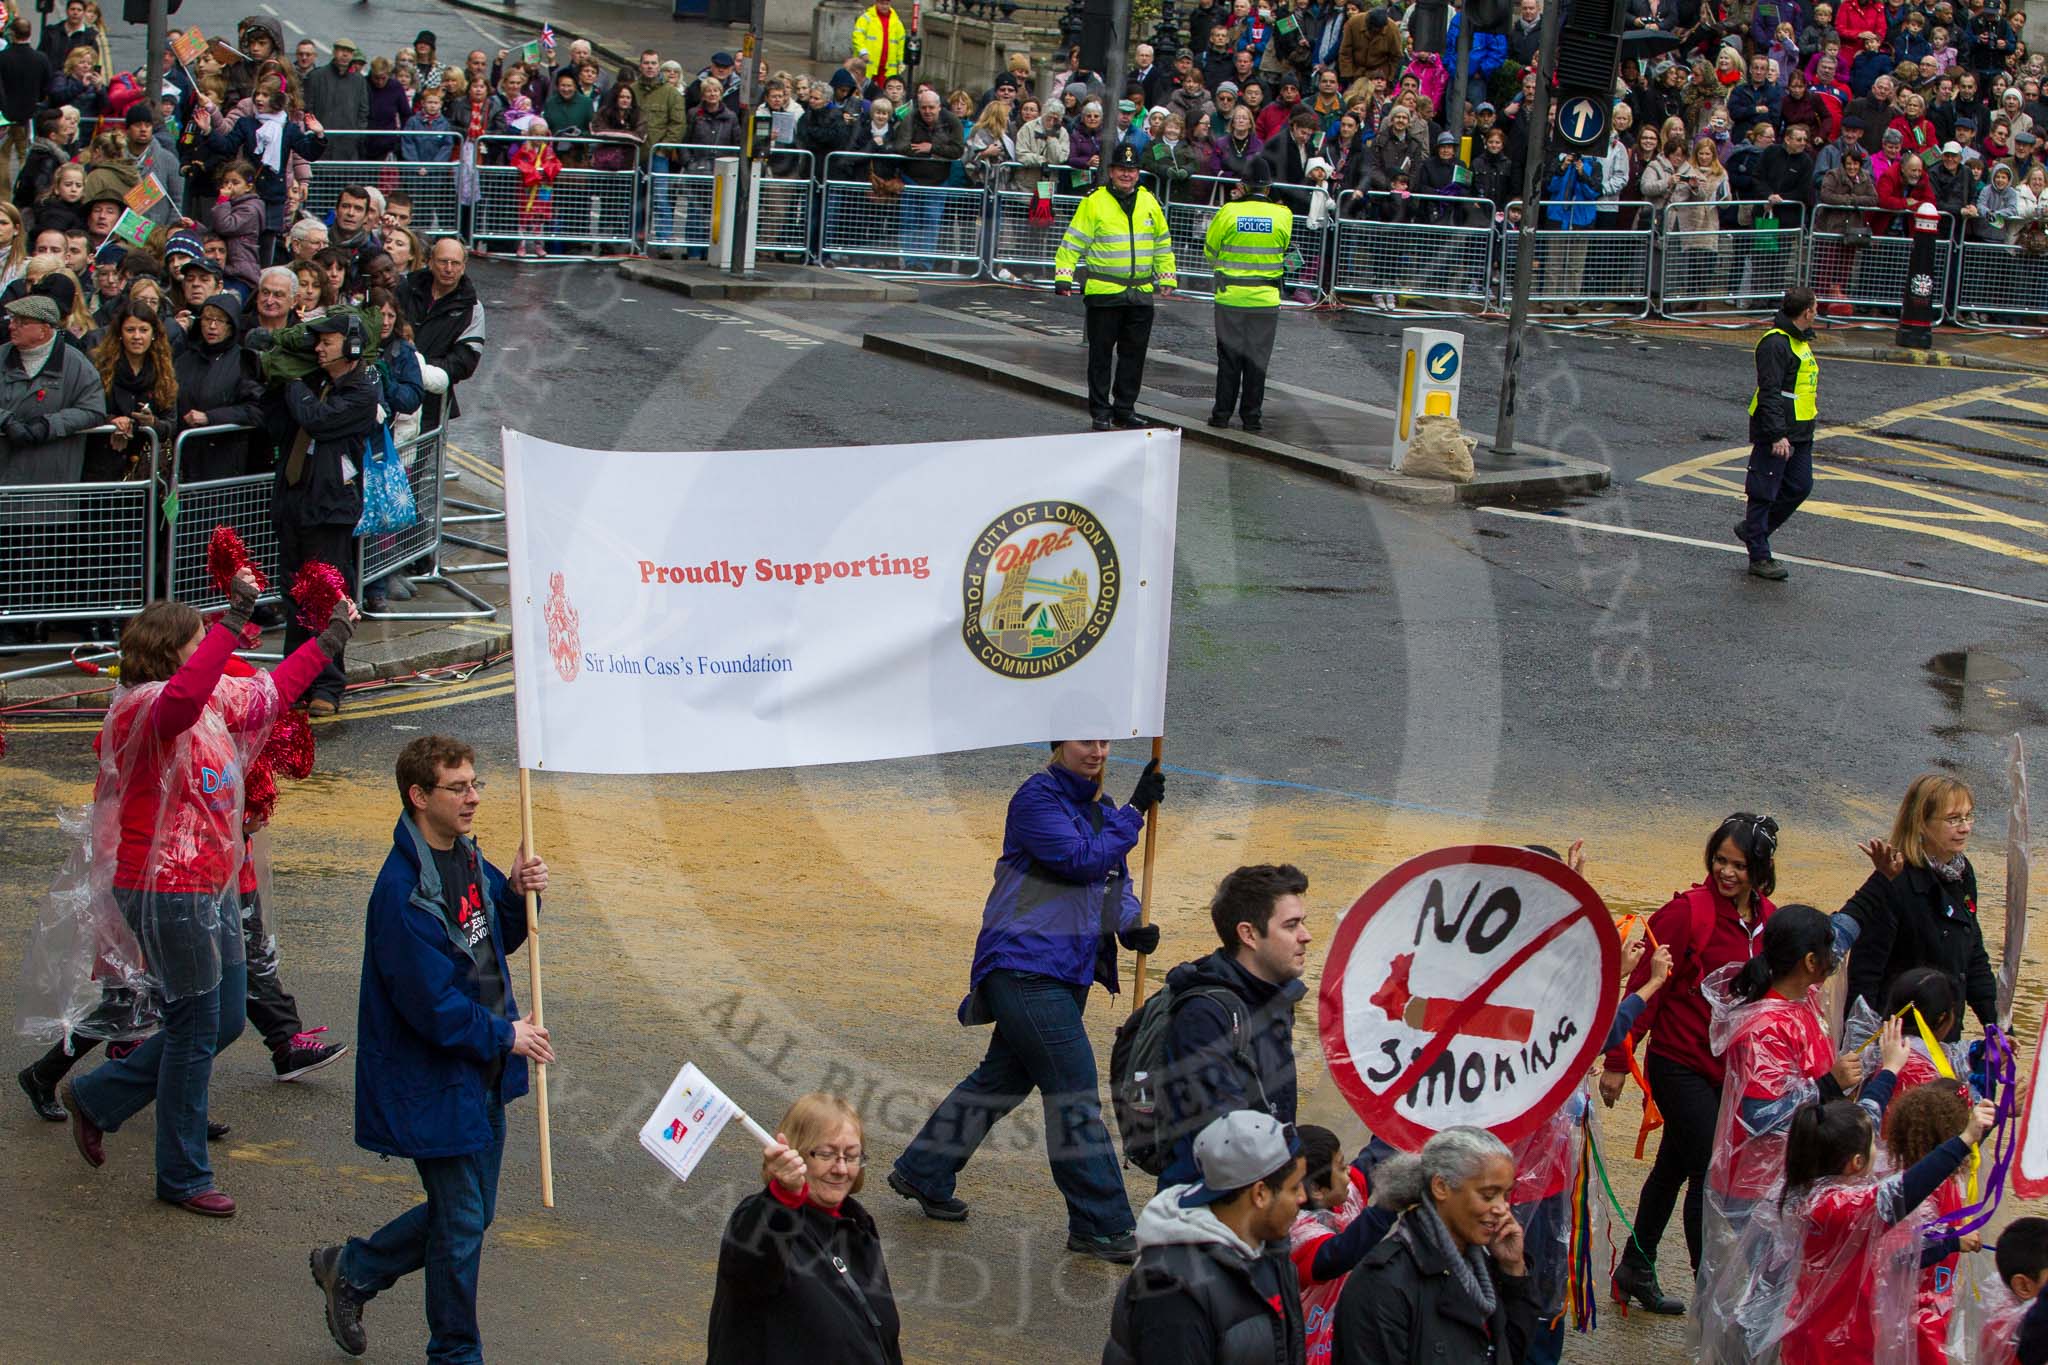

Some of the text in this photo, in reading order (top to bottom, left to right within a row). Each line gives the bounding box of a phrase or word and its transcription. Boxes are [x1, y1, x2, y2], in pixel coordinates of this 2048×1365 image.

[1238, 222, 1271, 232] POLICE
[978, 505, 1105, 557] CITY OF LONDON
[638, 553, 930, 588] Proudly Supporting
[966, 573, 983, 638] POLICE
[1087, 558, 1117, 639] SCHOOL
[585, 652, 793, 676] Sir John Cass's Foundation
[981, 643, 1081, 676] COMMUNITY
[1413, 878, 1521, 955] NO
